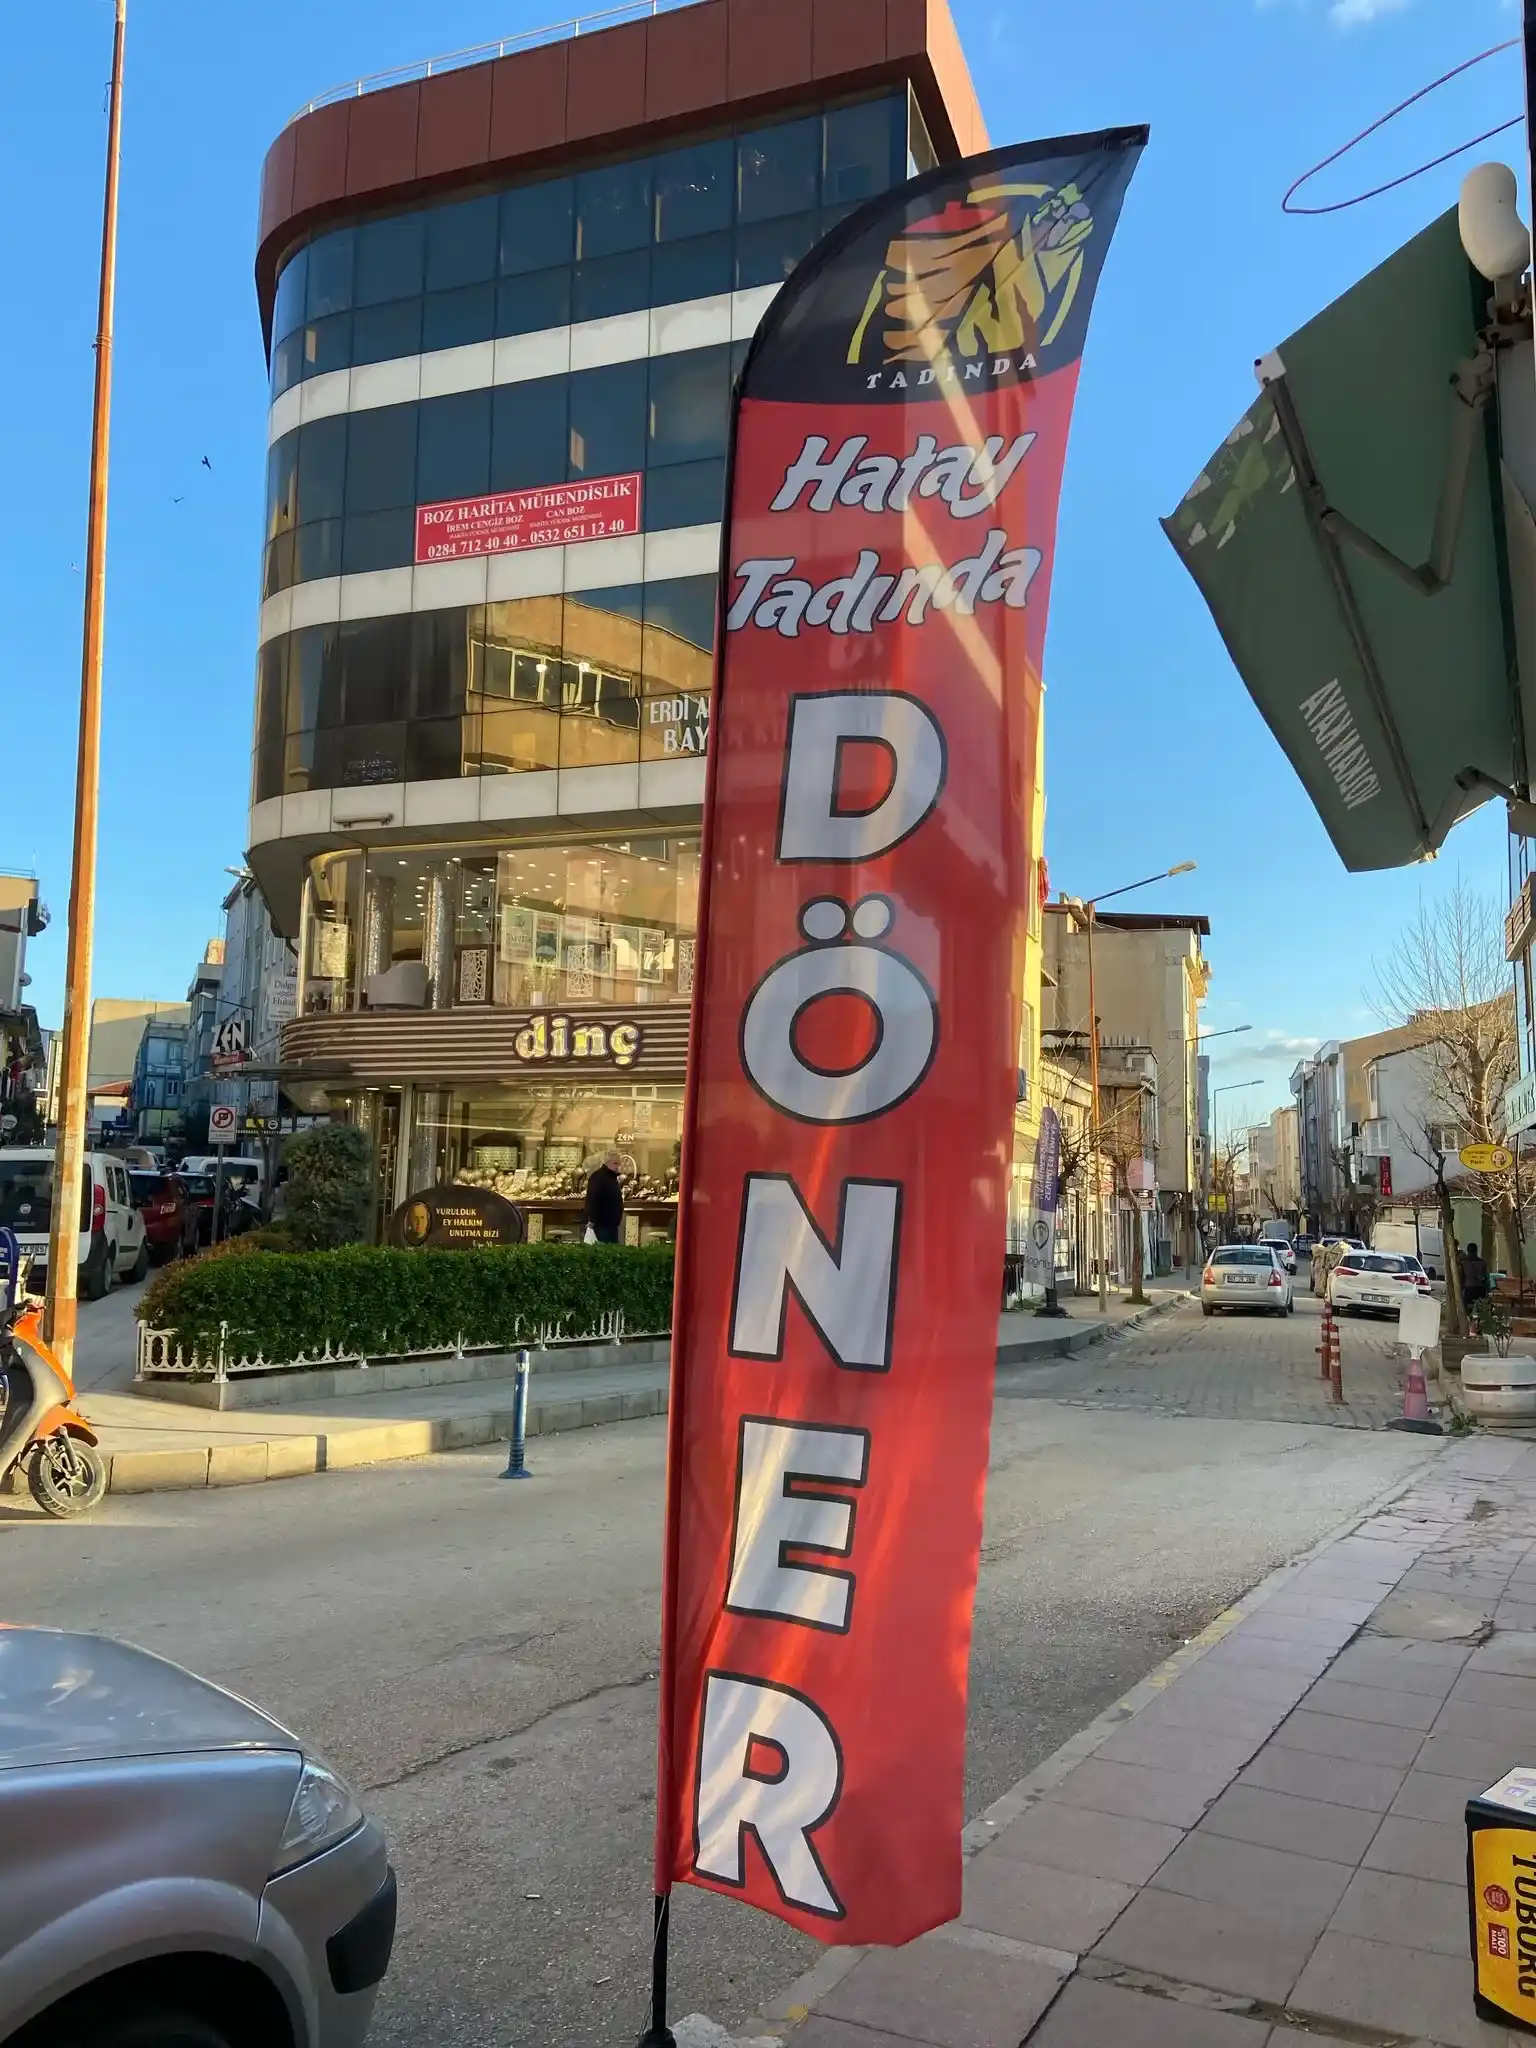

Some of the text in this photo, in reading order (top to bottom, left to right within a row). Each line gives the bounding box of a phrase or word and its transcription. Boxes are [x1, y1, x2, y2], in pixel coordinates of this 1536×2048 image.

[769, 432, 1038, 519] Hatay
[423, 481, 632, 525] BOZ HARİTA MÜHENDİSLİK
[546, 505, 585, 519] CAN BOZ
[428, 542, 457, 557] 0284
[460, 539, 481, 553] 712
[485, 536, 500, 549] 40
[503, 534, 518, 546] 40
[530, 528, 560, 544] 0532
[563, 524, 585, 539] 651
[591, 521, 605, 535] 12
[609, 519, 625, 532] 40
[446, 514, 524, 533] İREM CENGİZ BOZ
[727, 530, 1042, 637] Tadında
[210, 1019, 245, 1055] ZEN
[515, 1016, 639, 1065] dinç
[617, 1133, 635, 1141] ZEN
[443, 1218, 483, 1226] EY HALKIM
[449, 1229, 481, 1237] UNUTMA
[691, 690, 948, 1923] DÖNER
[1512, 1854, 1536, 1999] TUBORG
